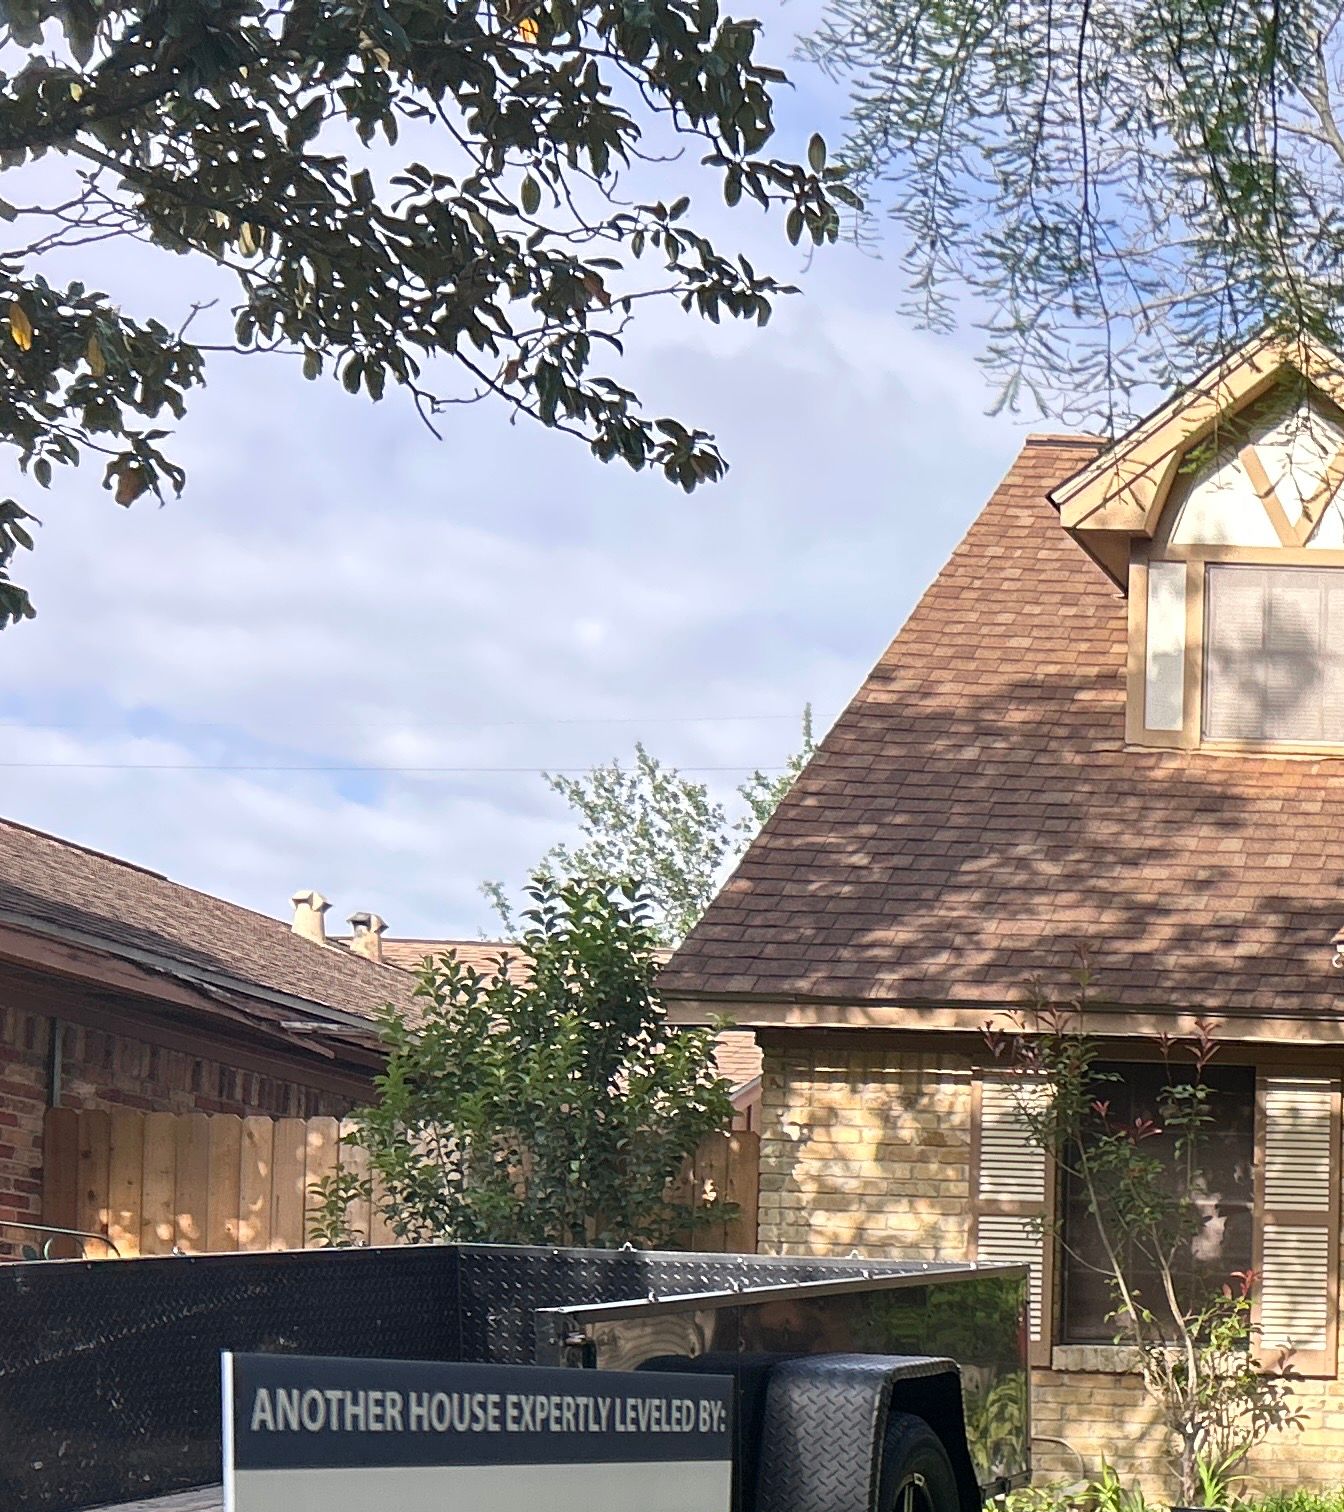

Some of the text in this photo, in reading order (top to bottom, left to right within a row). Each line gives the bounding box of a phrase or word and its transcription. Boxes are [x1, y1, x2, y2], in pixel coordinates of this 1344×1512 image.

[251, 1388, 726, 1433] ANOTHER HOUSE EXPERTLY LEVELED BY:
